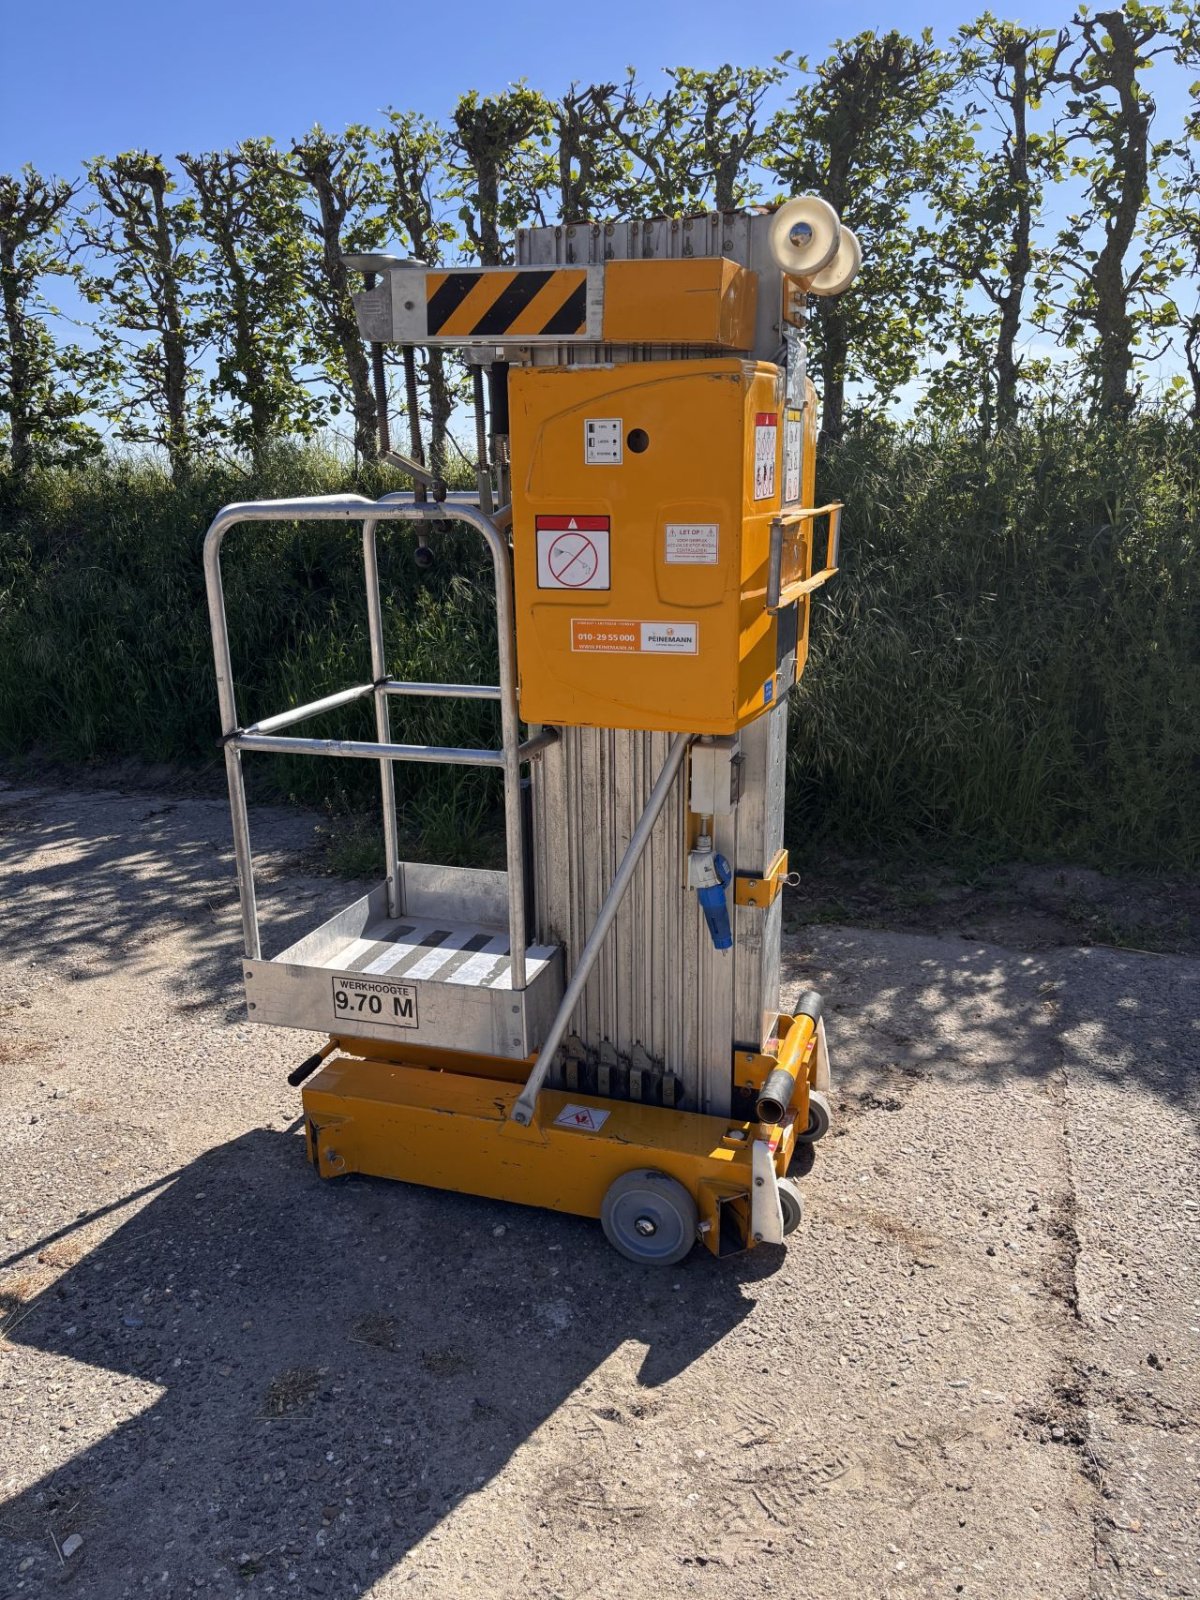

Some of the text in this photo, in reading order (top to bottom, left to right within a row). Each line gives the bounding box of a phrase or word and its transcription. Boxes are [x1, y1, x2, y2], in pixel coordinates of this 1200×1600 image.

[340, 980, 409, 996] WERKHOOGTE
[335, 990, 413, 1018] 9.70 M
